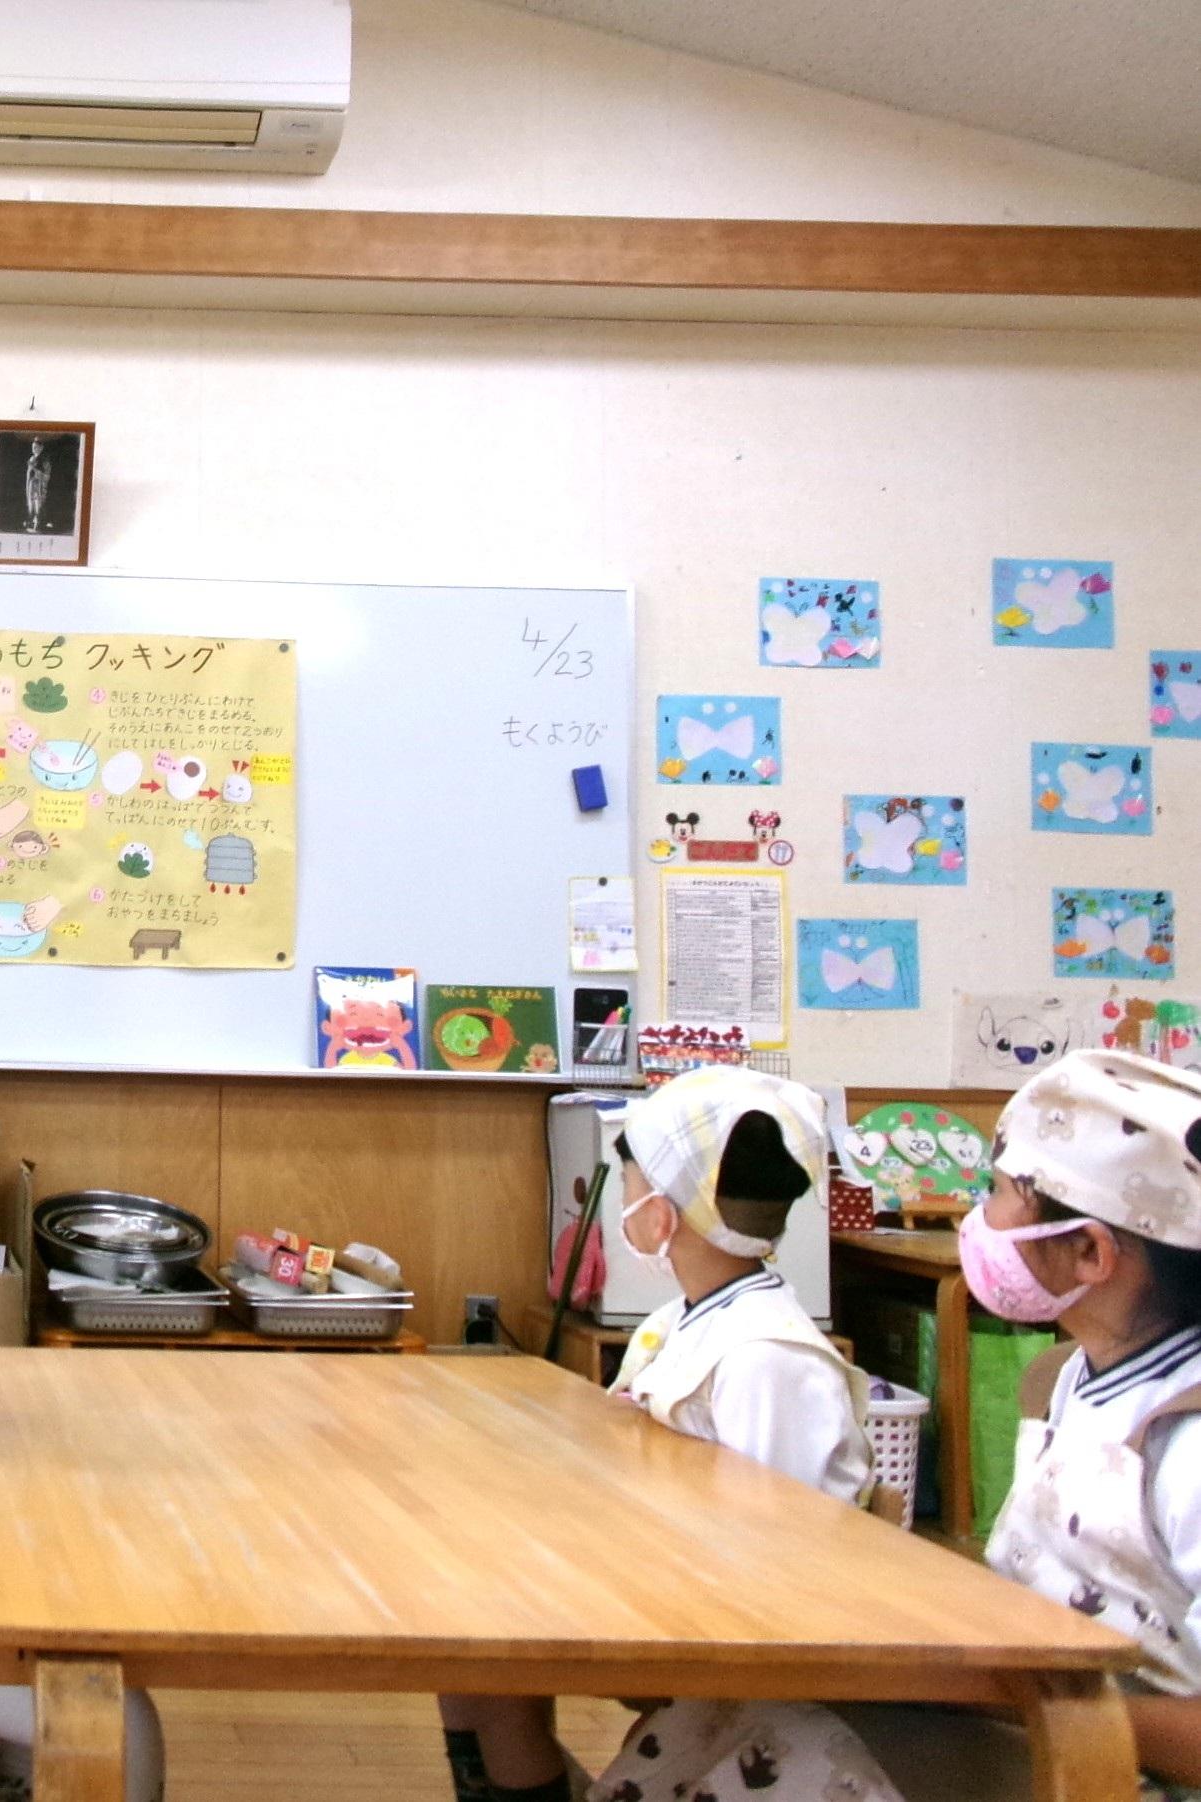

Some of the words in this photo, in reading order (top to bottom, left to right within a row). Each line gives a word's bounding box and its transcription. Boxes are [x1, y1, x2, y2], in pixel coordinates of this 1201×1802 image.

[86, 642, 225, 673] クッキング
[521, 616, 594, 680] 4/23
[502, 715, 608, 747] もくようび
[860, 1145, 871, 1157] 4
